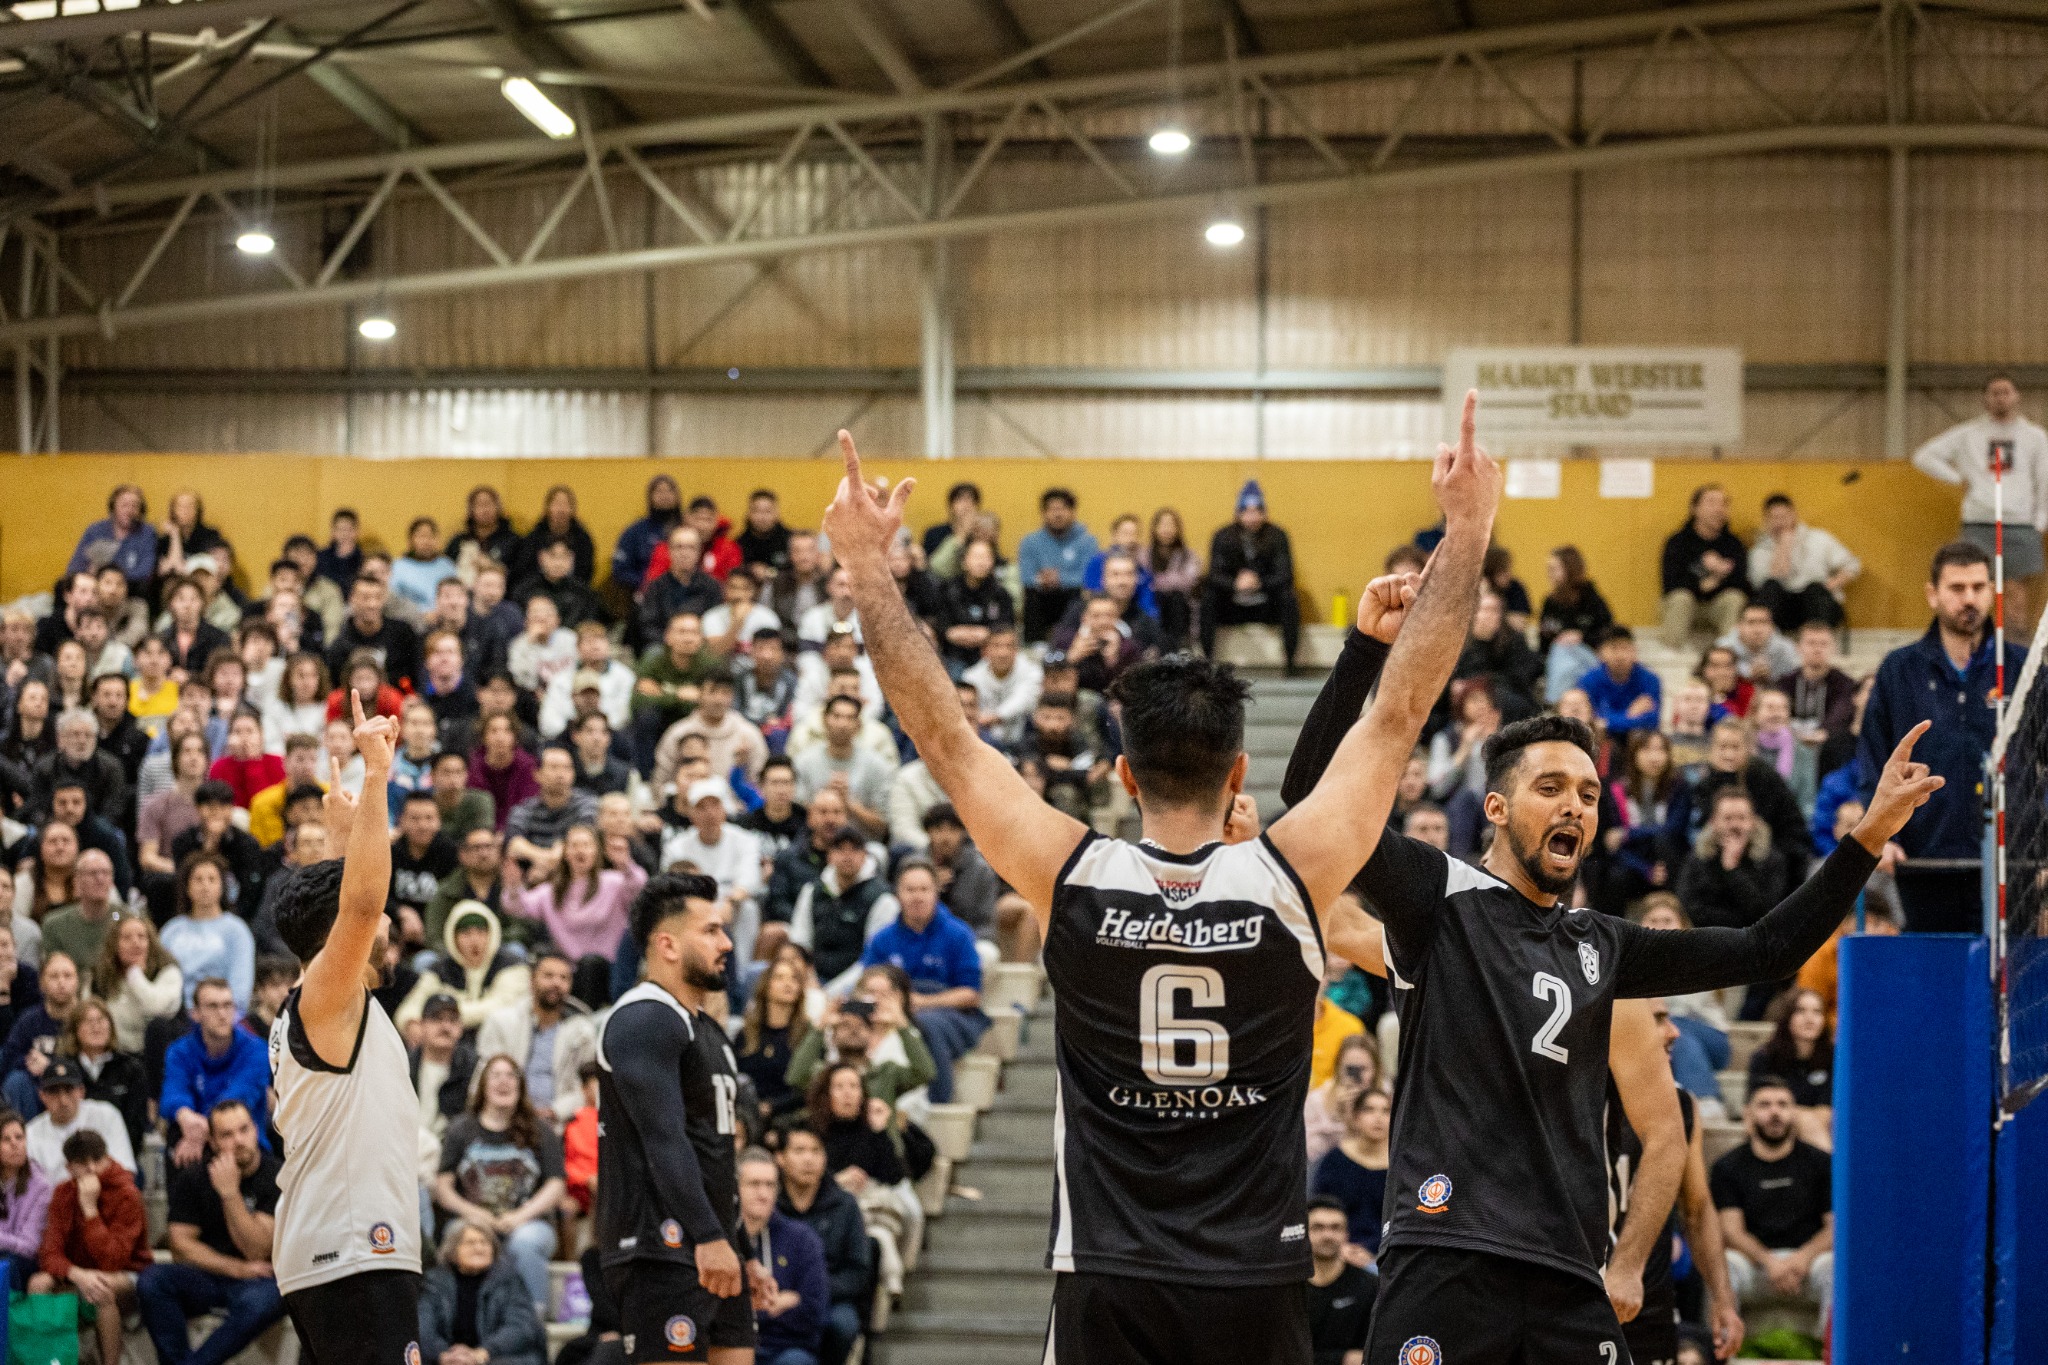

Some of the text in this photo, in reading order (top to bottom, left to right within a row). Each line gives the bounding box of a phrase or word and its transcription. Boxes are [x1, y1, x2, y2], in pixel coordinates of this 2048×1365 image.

[1589, 363, 1704, 389] WEBSTER
[1549, 393, 1633, 418] STAND
[1097, 907, 1264, 949] Heidelberg
[1096, 936, 1145, 950] VOLLEYBALL
[1140, 963, 1230, 1086] 6
[1531, 971, 1573, 1065] 2
[1109, 1085, 1267, 1110] GLENOAK
